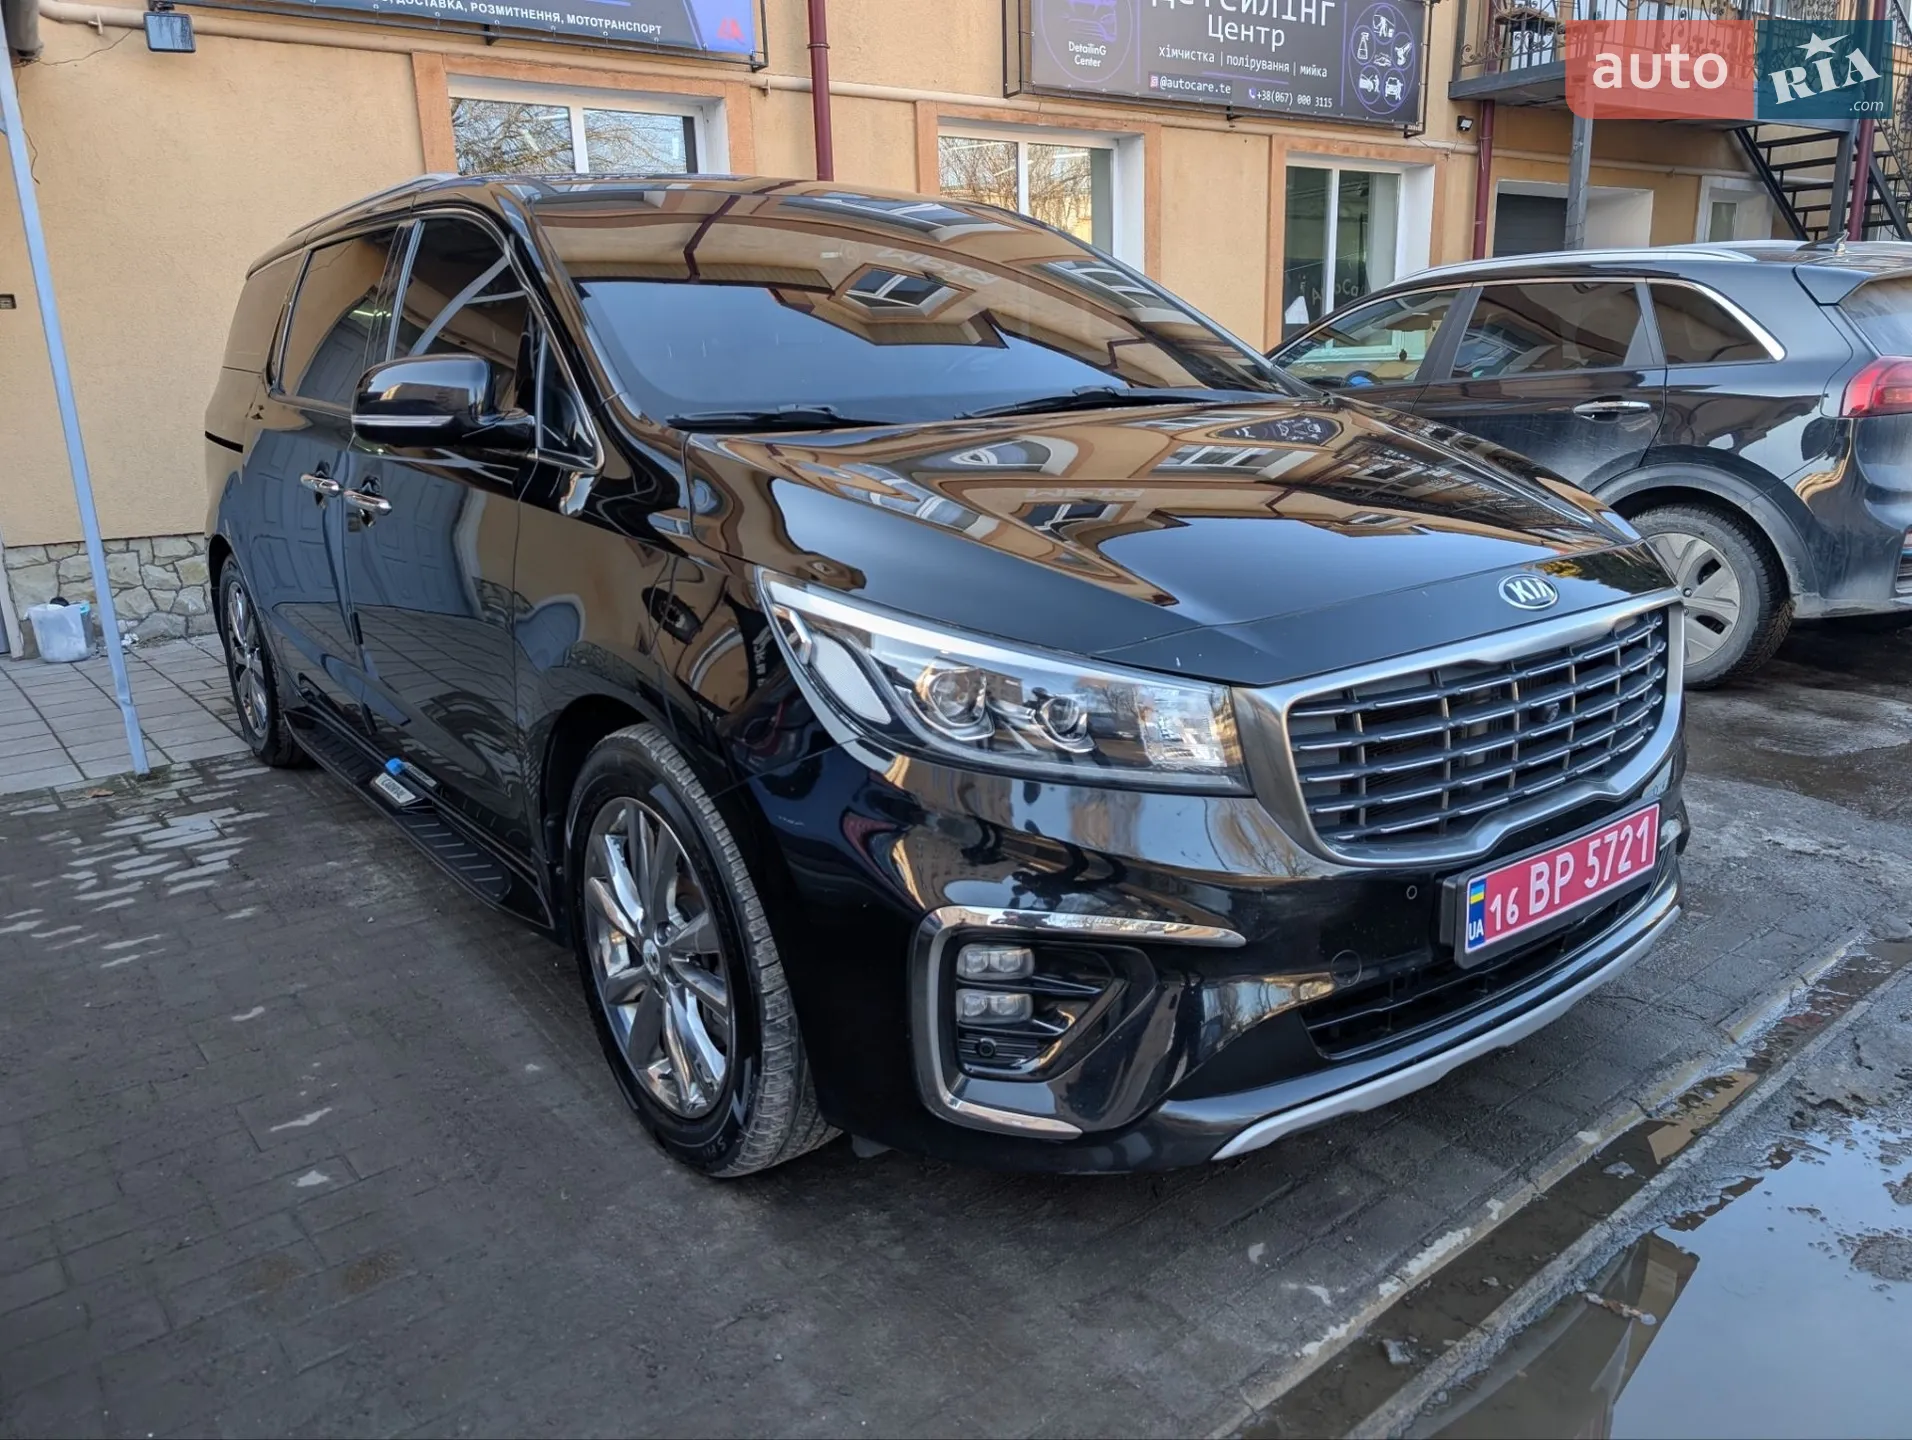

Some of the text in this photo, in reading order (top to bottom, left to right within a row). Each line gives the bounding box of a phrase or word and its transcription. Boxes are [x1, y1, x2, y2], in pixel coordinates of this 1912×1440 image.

[470, 2, 565, 24] РОЗМИТНЕННЯ,
[567, 14, 662, 35] МОТОТРАНСПОРТ
[1208, 14, 1285, 52] Центр
[1226, 53, 1290, 73] полірування
[1300, 63, 1328, 78] мийка
[1160, 75, 1231, 95] @autocare.te
[1506, 578, 1555, 603] KIA
[1489, 815, 1650, 931] 16 BP 5721
[1468, 922, 1484, 940] UA
